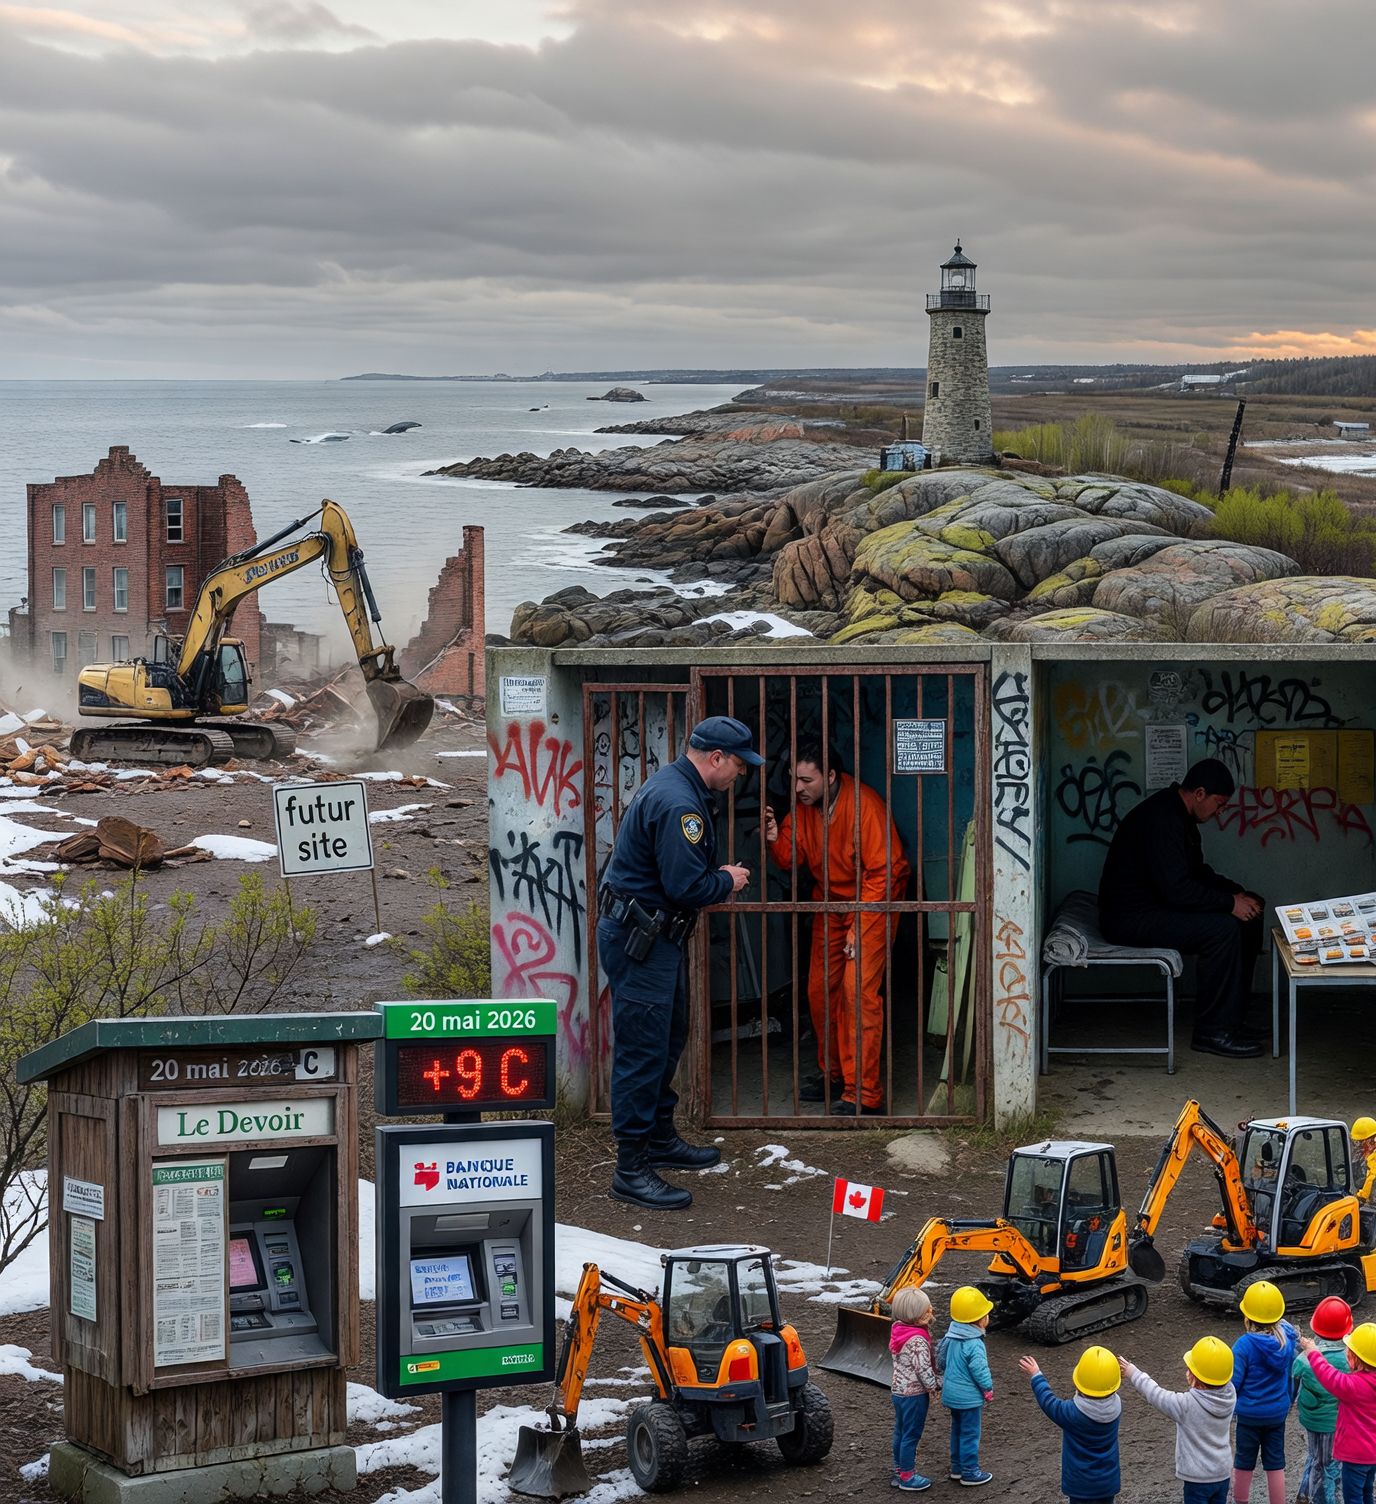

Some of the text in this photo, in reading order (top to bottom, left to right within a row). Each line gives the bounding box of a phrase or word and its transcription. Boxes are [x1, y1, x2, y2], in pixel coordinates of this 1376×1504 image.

[285, 795, 355, 826] futur
[298, 832, 348, 861] site
[410, 1010, 536, 1032] 20 mai 2026
[150, 1059, 179, 1081] 20
[185, 1057, 230, 1079] mai
[303, 1050, 319, 1075] C
[423, 1048, 528, 1099] +9 C
[177, 1106, 305, 1137] Le Devoir
[446, 1159, 514, 1174] BANQUE
[447, 1175, 528, 1190] NATIONALE
